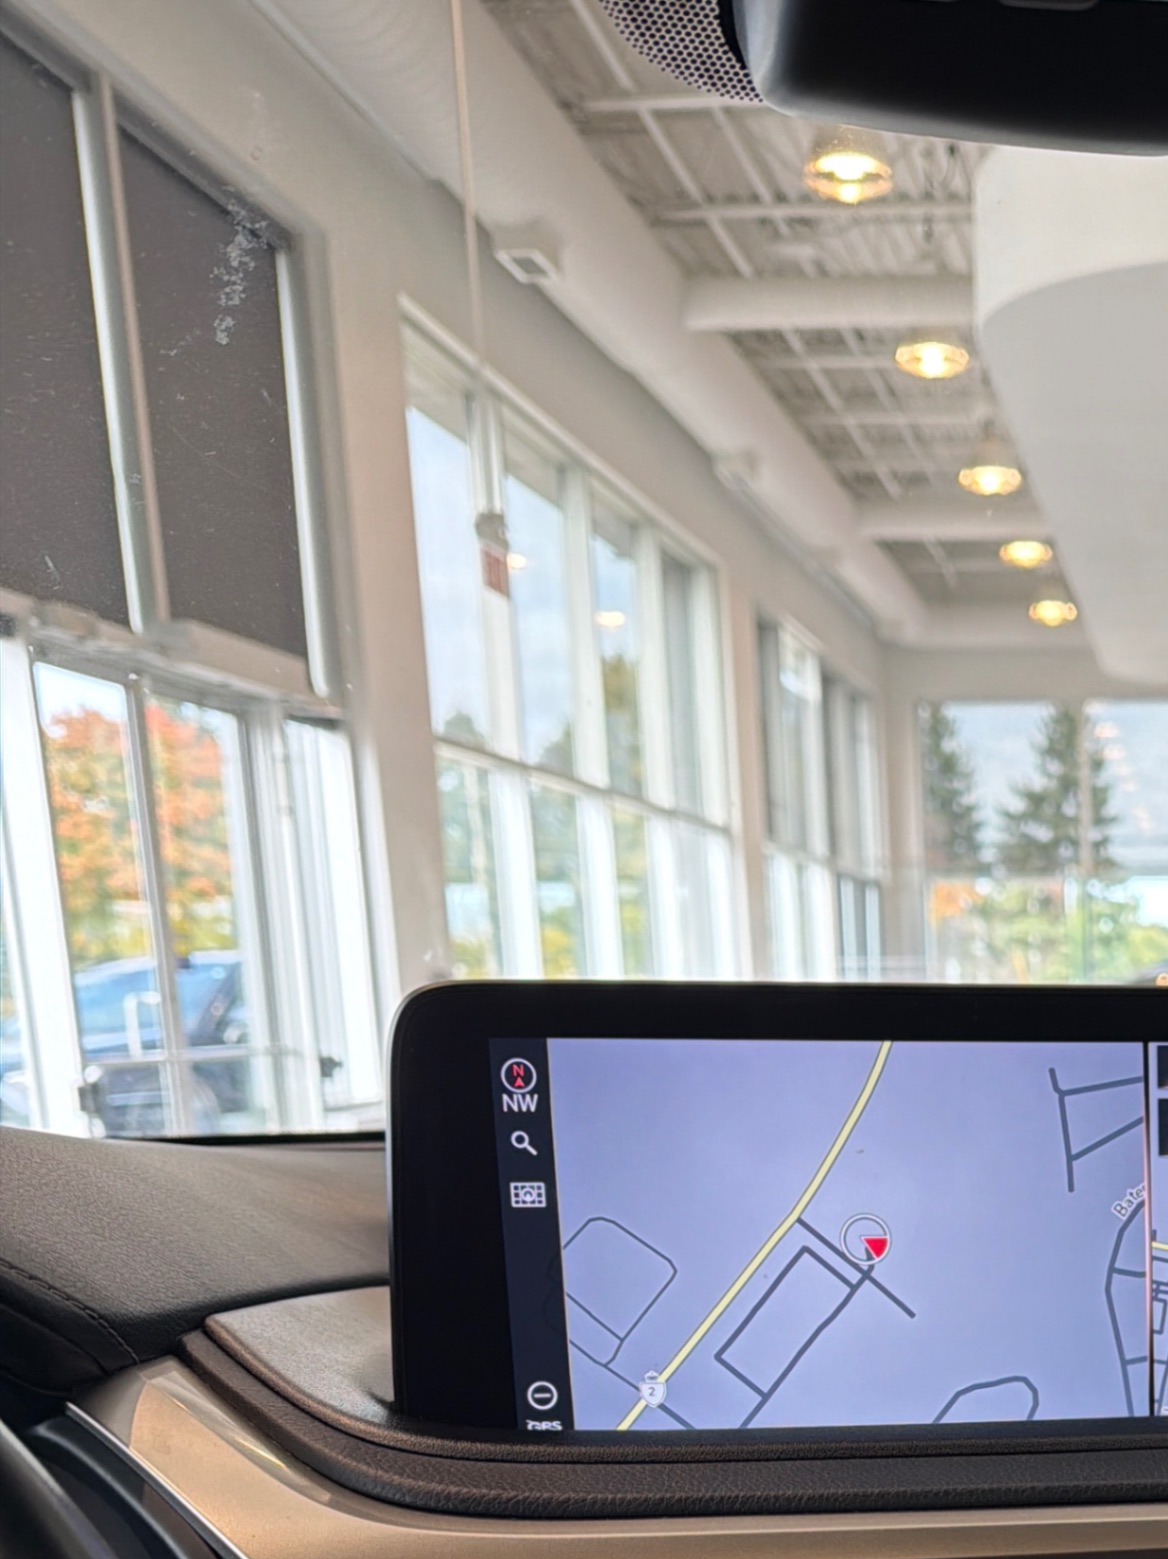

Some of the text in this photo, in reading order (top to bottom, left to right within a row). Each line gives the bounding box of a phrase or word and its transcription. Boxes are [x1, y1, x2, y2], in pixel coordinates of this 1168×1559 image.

[512, 1064, 525, 1077] N
[502, 1093, 538, 1113] NW
[647, 1386, 656, 1397] 2
